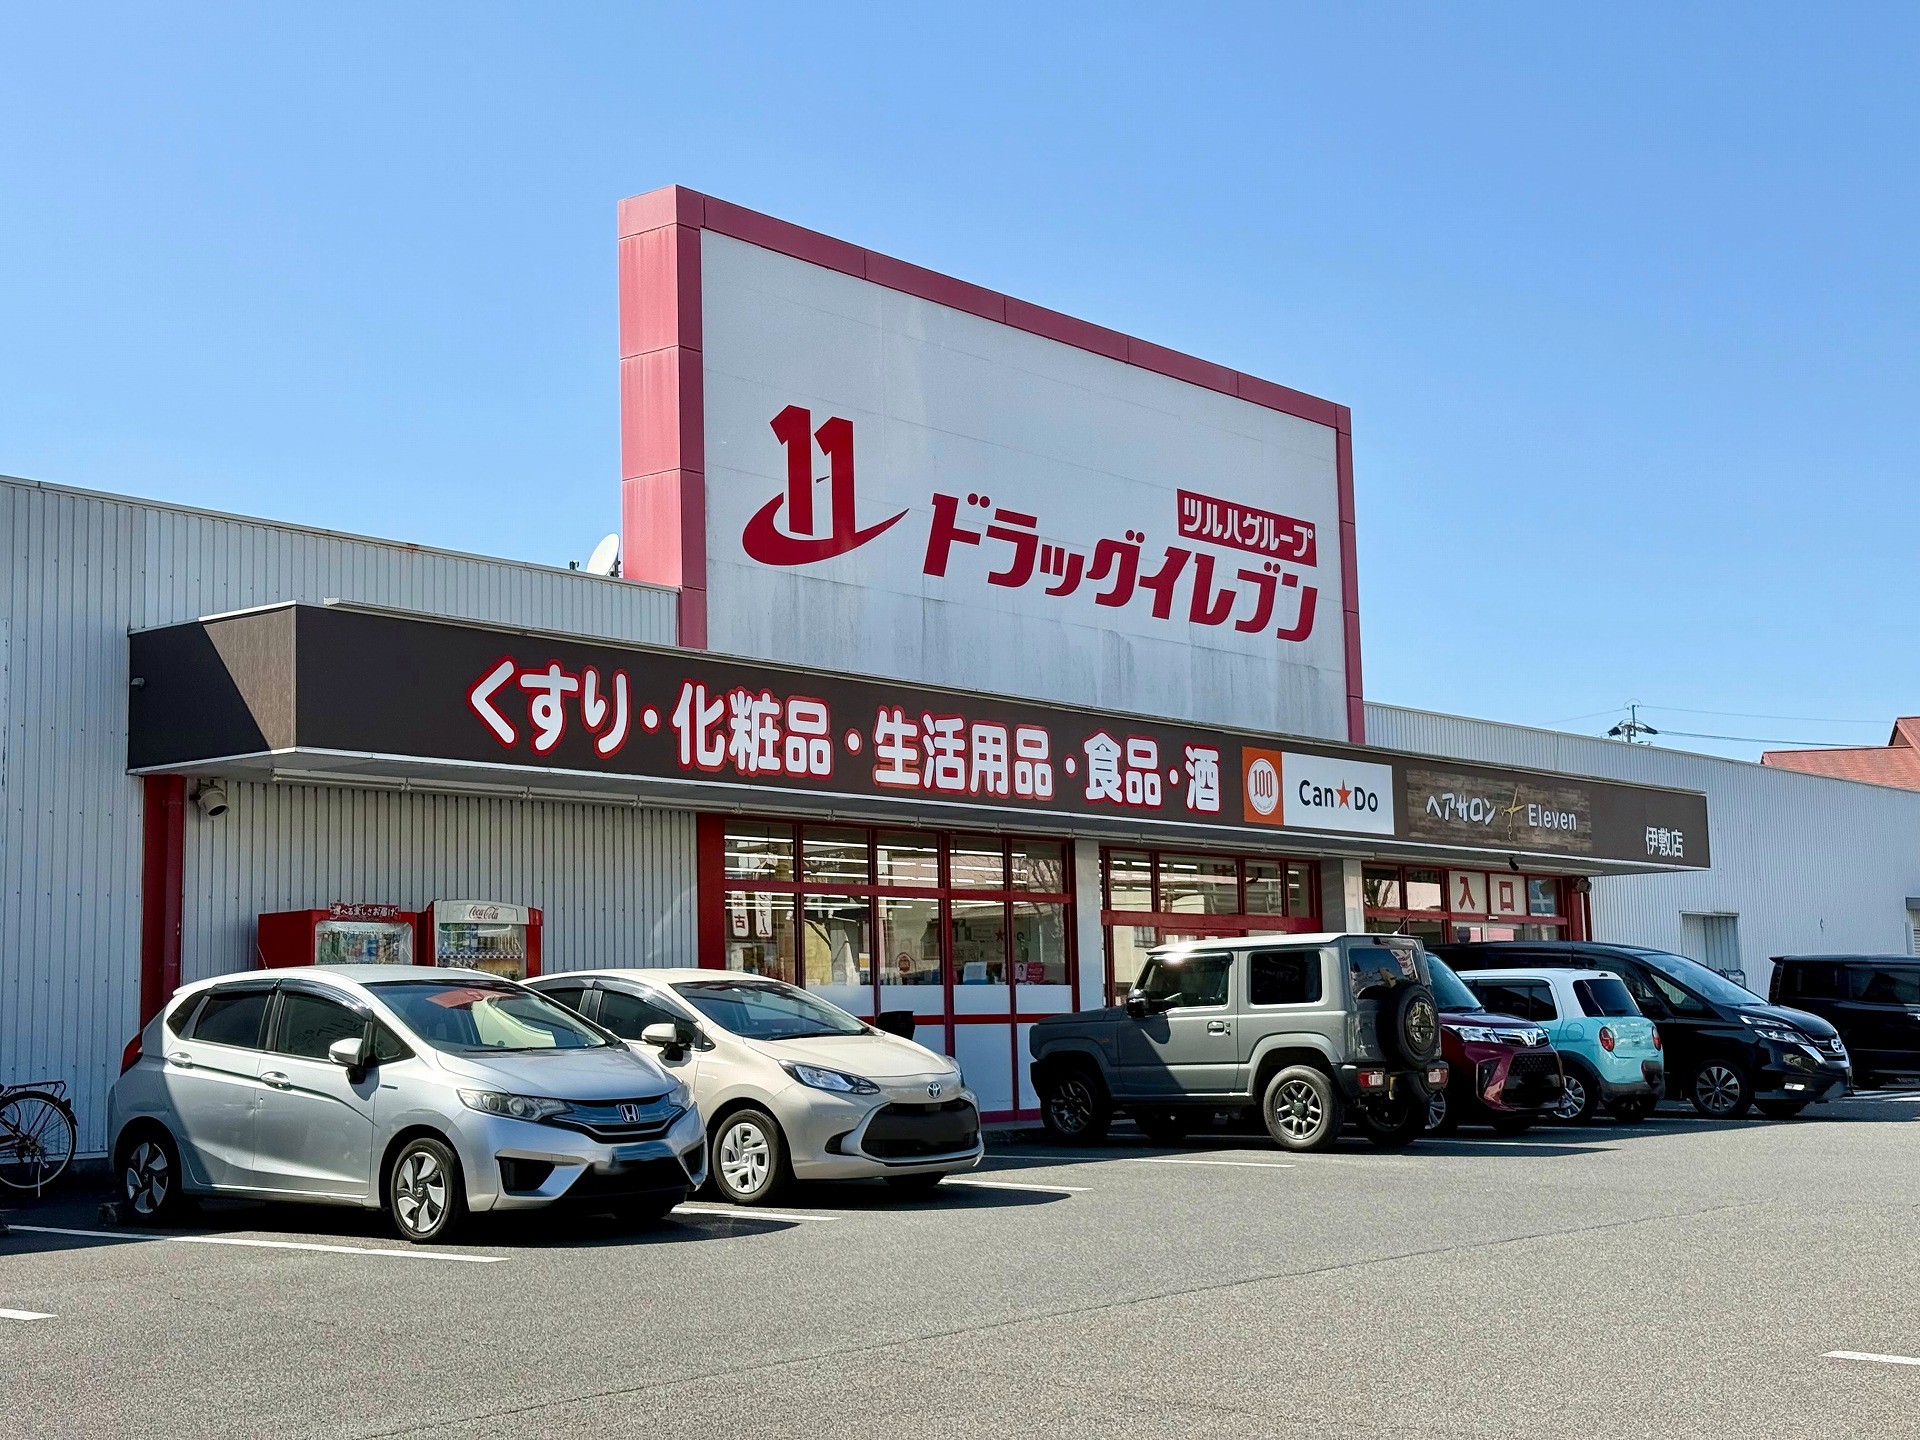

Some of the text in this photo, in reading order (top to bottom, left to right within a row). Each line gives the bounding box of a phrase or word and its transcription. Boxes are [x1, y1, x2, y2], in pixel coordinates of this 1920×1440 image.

[1184, 497, 1313, 557] ツルハグループ
[923, 493, 1318, 642] ドラッグイレブン
[1253, 768, 1273, 799] 100
[1425, 792, 1578, 831] ヘアサロン Eleven
[1645, 826, 1684, 858] 伊敷店
[1458, 876, 1515, 912] 入口
